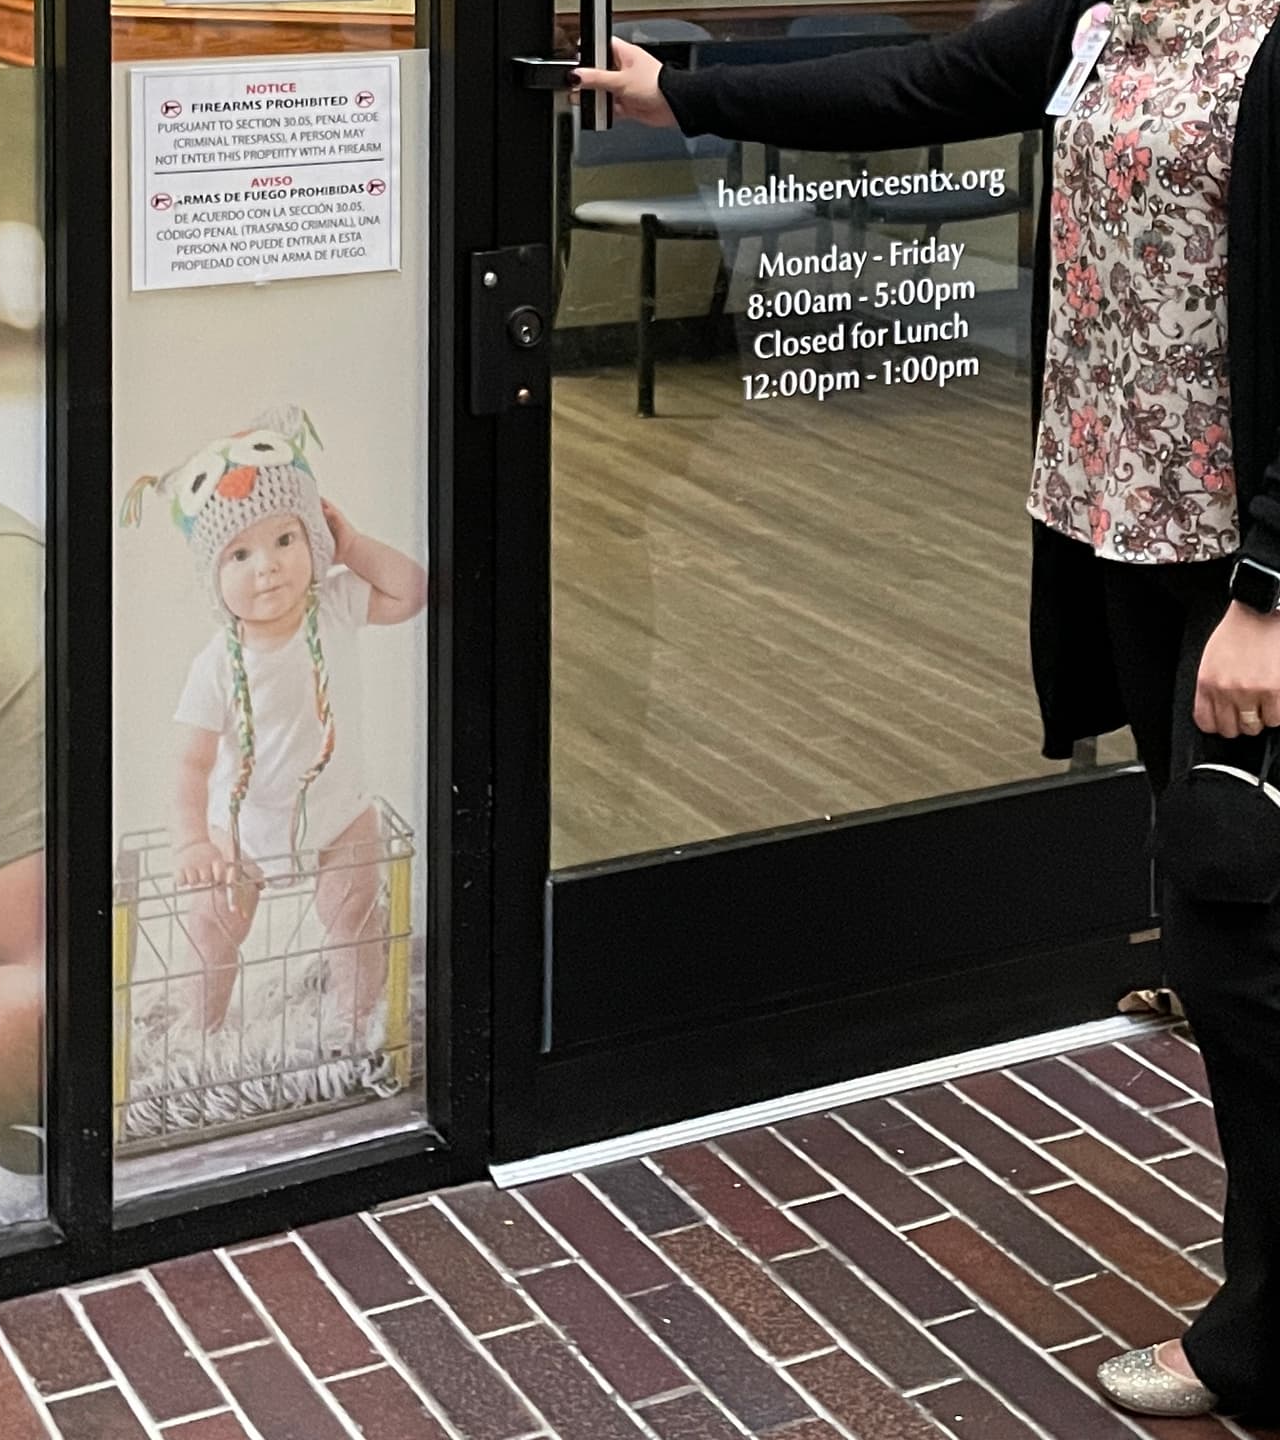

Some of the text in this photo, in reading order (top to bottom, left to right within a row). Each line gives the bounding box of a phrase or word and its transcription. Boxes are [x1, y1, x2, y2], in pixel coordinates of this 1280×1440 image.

[246, 83, 297, 95] NOTICE
[192, 96, 348, 113] FIREARMS PROHIBITED
[158, 120, 216, 134] PURSUANT
[219, 119, 233, 131] TO
[235, 117, 280, 129] SECTION
[316, 113, 348, 126] PENAL
[351, 111, 379, 123] CODE
[173, 137, 229, 150] (CRIMINAL
[290, 131, 298, 143] A
[300, 128, 340, 141] PERSON
[343, 126, 366, 139] MAY
[155, 141, 382, 166] NOT ENTER THIS PROPERTY WITH A FIREARM
[224, 191, 241, 203] DE
[244, 188, 288, 202] FUEGO
[290, 183, 365, 199] PROHIBIDAS
[251, 175, 293, 188] AVISO
[718, 167, 1006, 209] healthservicesntx.org
[174, 212, 189, 225] DE
[191, 209, 246, 224] ACUERDO
[247, 207, 271, 220] CON
[273, 206, 287, 218] LA
[204, 225, 238, 238] PENAL
[358, 215, 381, 227] UNA
[176, 231, 363, 257] PERSONA NO PUEDE ENTRAR A ESTA
[171, 257, 234, 272] PROPIEDAD
[236, 255, 260, 267] CON
[262, 253, 279, 266] UN
[281, 251, 312, 263] ARMA
[314, 249, 328, 261] DE
[759, 244, 868, 279] Monday
[889, 237, 965, 269] Friday
[747, 290, 852, 321] 8:00am
[874, 279, 976, 313] 5:00pm
[754, 313, 969, 360] Closed for Lunch
[742, 370, 860, 401] 12:00pm
[882, 355, 980, 387] 1:00pm
